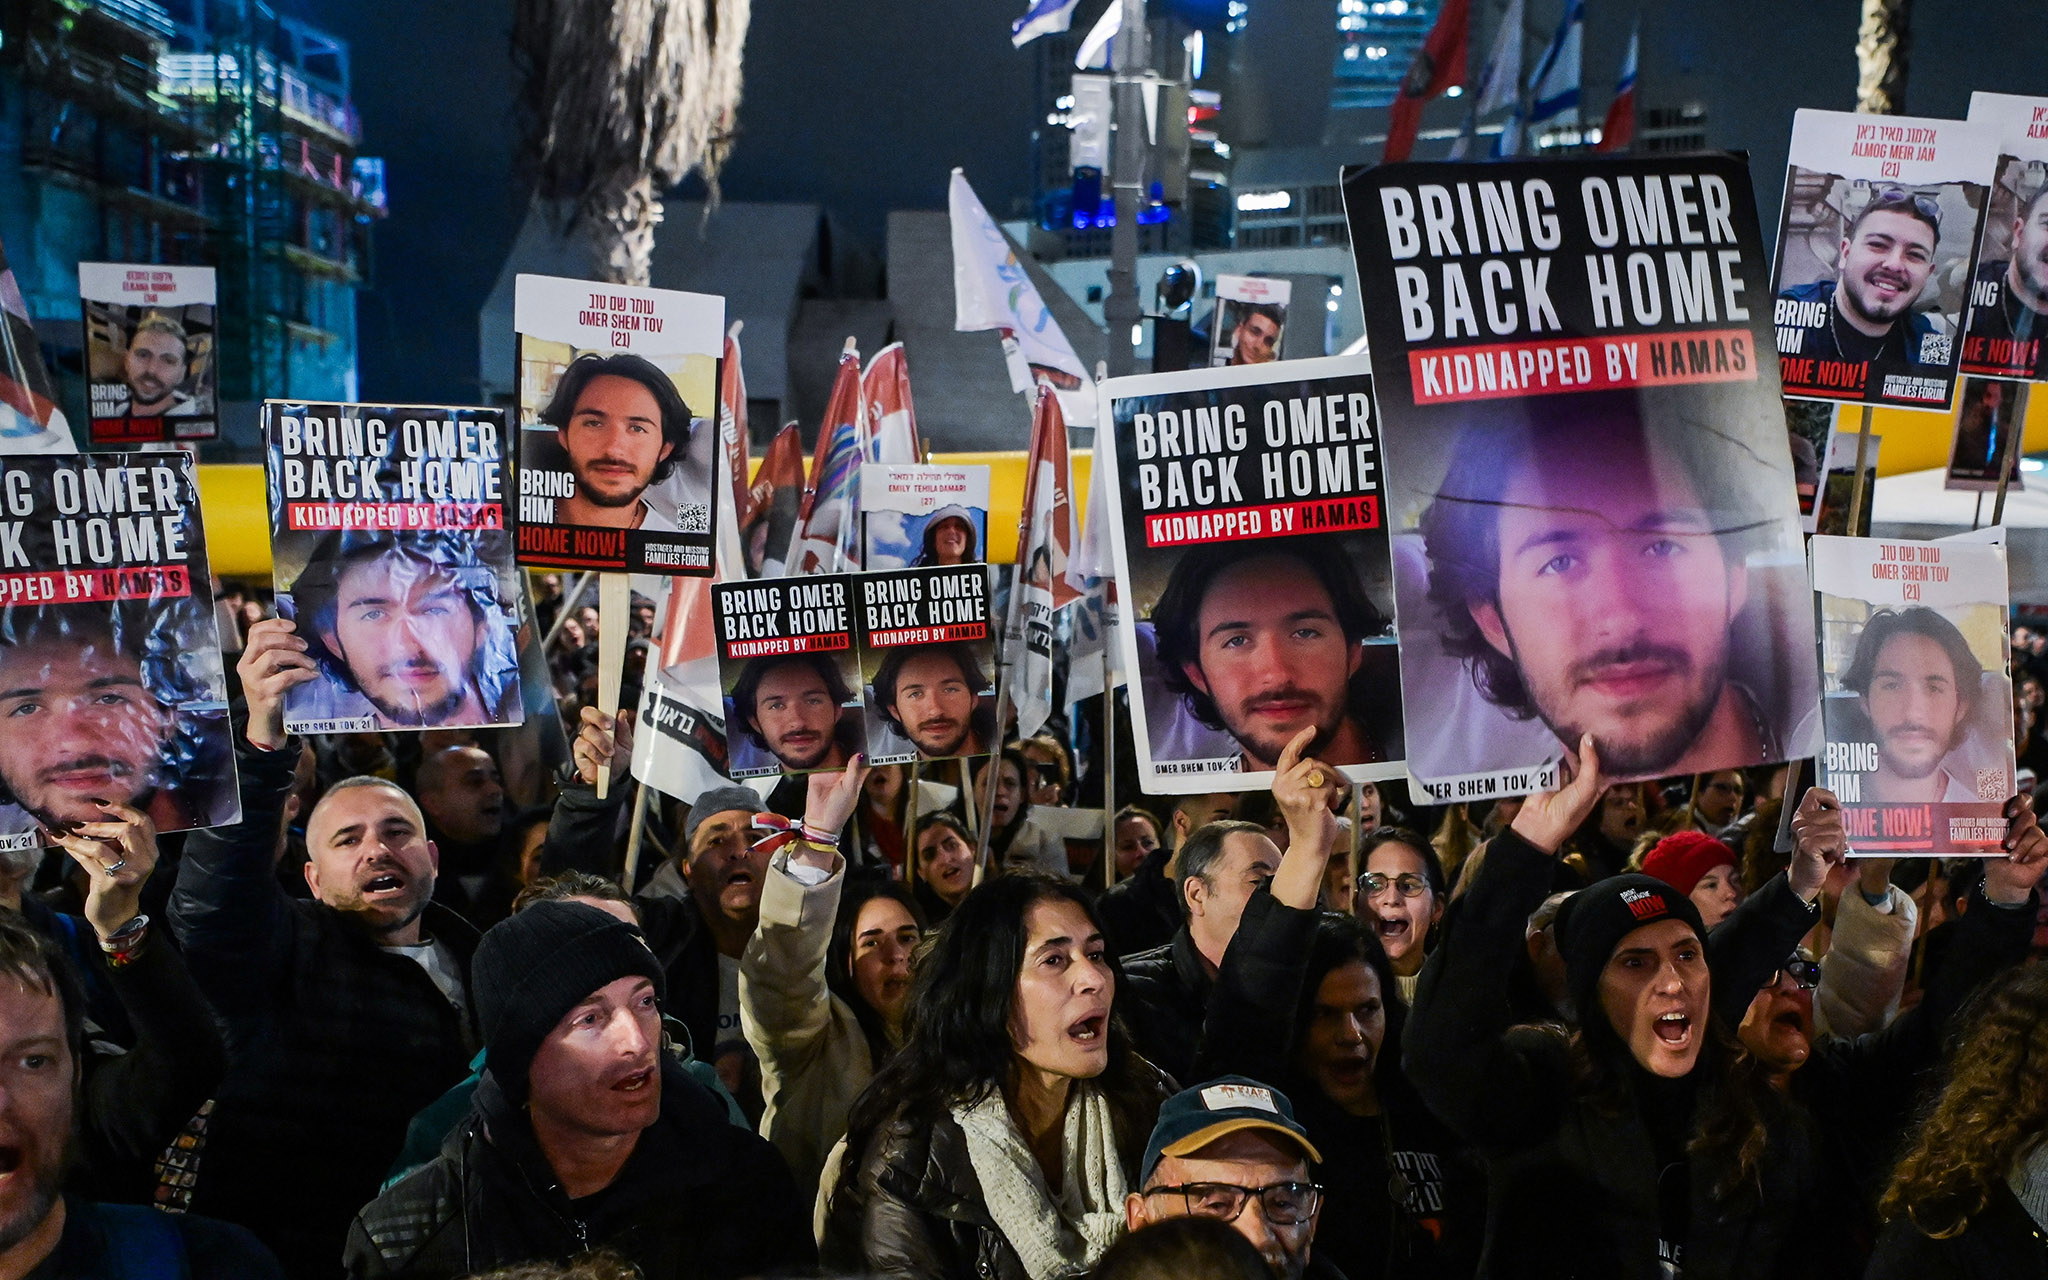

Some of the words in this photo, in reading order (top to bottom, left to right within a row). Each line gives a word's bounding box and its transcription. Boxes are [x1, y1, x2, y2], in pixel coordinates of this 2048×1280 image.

[1880, 126, 1904, 142] מאיר
[1907, 127, 1937, 144] אלמוג
[1852, 142, 1886, 158] ALMOG
[1889, 144, 1914, 160] MEIR
[1916, 146, 1936, 162] JAN
[1881, 161, 1901, 178] (21)
[1379, 177, 1562, 261] BRING
[1580, 173, 1738, 249] OMER
[589, 294, 606, 310] טוב
[610, 296, 627, 312] שם
[630, 298, 654, 315] עומר
[1394, 256, 1562, 343] BACK
[1585, 249, 1751, 329] HOME
[579, 311, 608, 327] OMER
[611, 315, 640, 331] SHEM
[643, 317, 663, 333] TOV
[1774, 299, 1827, 328] BRING
[611, 332, 630, 348] (21)
[1988, 339, 2040, 367] NOW!
[1420, 346, 1593, 397] KIDNAPPED
[1604, 341, 1639, 382] BY
[1650, 336, 1748, 377] HAMAS
[1780, 359, 1813, 385] OME
[1817, 360, 1869, 390] NOW!
[91, 384, 127, 401] BRING
[1883, 385, 1918, 399] FAMILIES
[1918, 386, 1946, 400] FORUM
[281, 416, 389, 458] BRING
[402, 419, 499, 459] OMER
[1133, 404, 1248, 461] BRING
[1263, 393, 1373, 448] OMER
[284, 459, 383, 499] BACK
[400, 461, 502, 500] HOME
[519, 469, 575, 498] BRING
[1139, 456, 1244, 511] BACK
[1261, 443, 1377, 499] HOME
[0, 469, 35, 517] G
[53, 466, 179, 515] OMER
[888, 484, 911, 493] EMILY
[914, 485, 938, 493] TEHILA
[939, 484, 967, 492] DAMARI
[295, 506, 399, 527] KIDNAPPED
[407, 506, 430, 527] BY
[519, 496, 554, 524] HIM
[1151, 510, 1262, 543] KIDNAPPED
[1270, 507, 1294, 533] BY
[1301, 501, 1372, 530] HAMAS
[52, 515, 188, 566] HOME
[518, 526, 569, 554] HOME
[574, 529, 627, 558] NOW!
[645, 543, 673, 553] HOSTAGES
[673, 545, 685, 554] AND
[644, 551, 680, 565] FAMILIES
[681, 553, 709, 567] FORUM
[1880, 544, 1896, 561] טוב
[1899, 545, 1915, 562] שם
[1919, 546, 1940, 563] עומר
[1872, 563, 1899, 580] OMER
[1902, 565, 1929, 582] SHEM
[1931, 566, 1949, 582] TOV
[65, 574, 93, 599] BY
[102, 570, 183, 597] HAMAS
[863, 577, 922, 605] BRING
[929, 573, 984, 600] OMER
[1902, 583, 1920, 601] (21)
[721, 587, 782, 615] BRING
[789, 583, 846, 609] OMER
[724, 613, 779, 641] BACK
[788, 607, 848, 635] HOME
[866, 603, 920, 630] BACK
[928, 598, 986, 625] HOME
[872, 630, 929, 646] KIDNAPPED
[932, 628, 946, 641] BY
[948, 624, 984, 639] HAMAS
[731, 640, 790, 657] KIDNAPPED
[793, 638, 807, 651] BY
[809, 636, 846, 650] HAMAS
[361, 720, 371, 730] 21
[1155, 764, 1178, 774] OMER
[1181, 763, 1204, 773] SHEM
[1229, 761, 1238, 770] 21
[1826, 742, 1879, 772] BRING
[1423, 783, 1451, 800] MER
[1458, 778, 1496, 796] SHEM
[1540, 771, 1553, 787] 21
[1828, 774, 1861, 803] HIM
[1841, 807, 1878, 837] OME
[1882, 804, 1933, 837] NOW!
[1949, 817, 1975, 827] HOSTAGES
[21, 836, 33, 848] 21
[1950, 828, 1983, 841] FAMILIES
[1628, 894, 1666, 918] NOW
